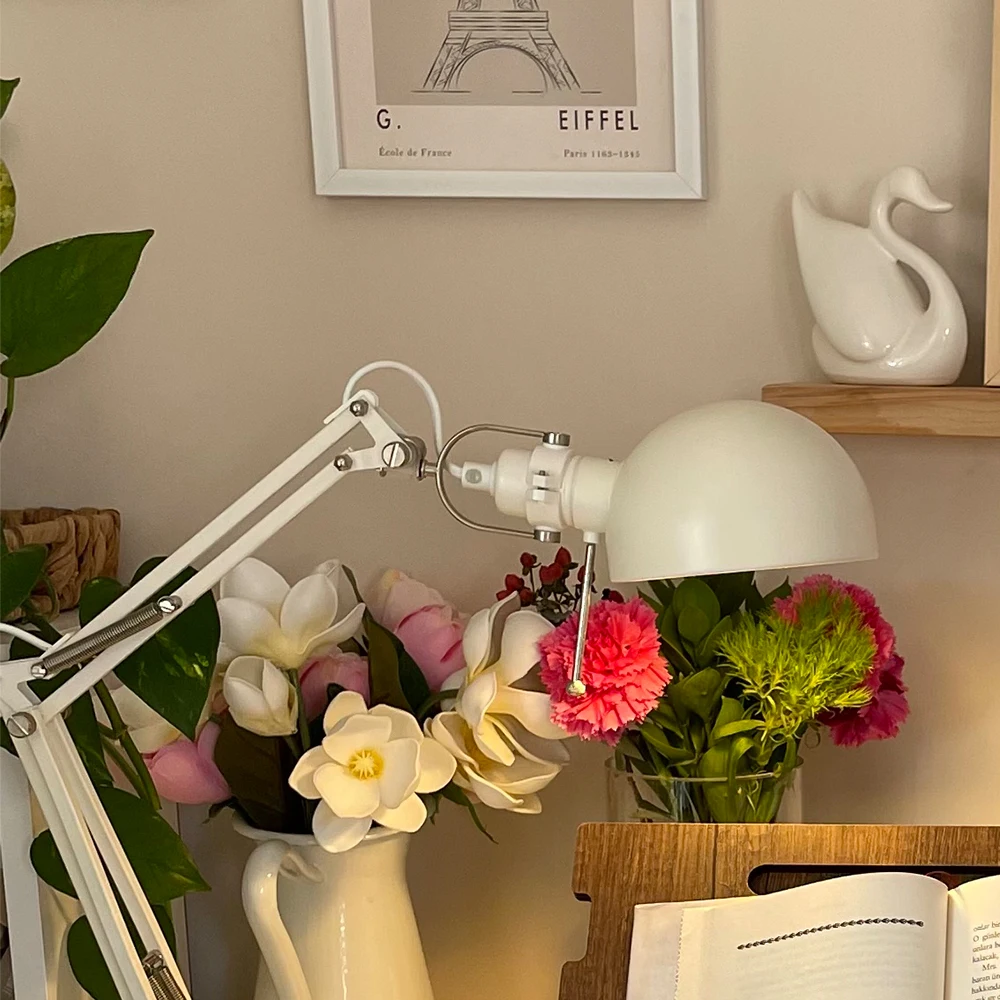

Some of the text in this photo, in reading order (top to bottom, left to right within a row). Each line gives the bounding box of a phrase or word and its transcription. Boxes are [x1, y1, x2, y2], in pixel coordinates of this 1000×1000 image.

[376, 108, 640, 131] G. EIFFEL
[378, 145, 453, 157] École de France
[563, 148, 588, 158] Paris
